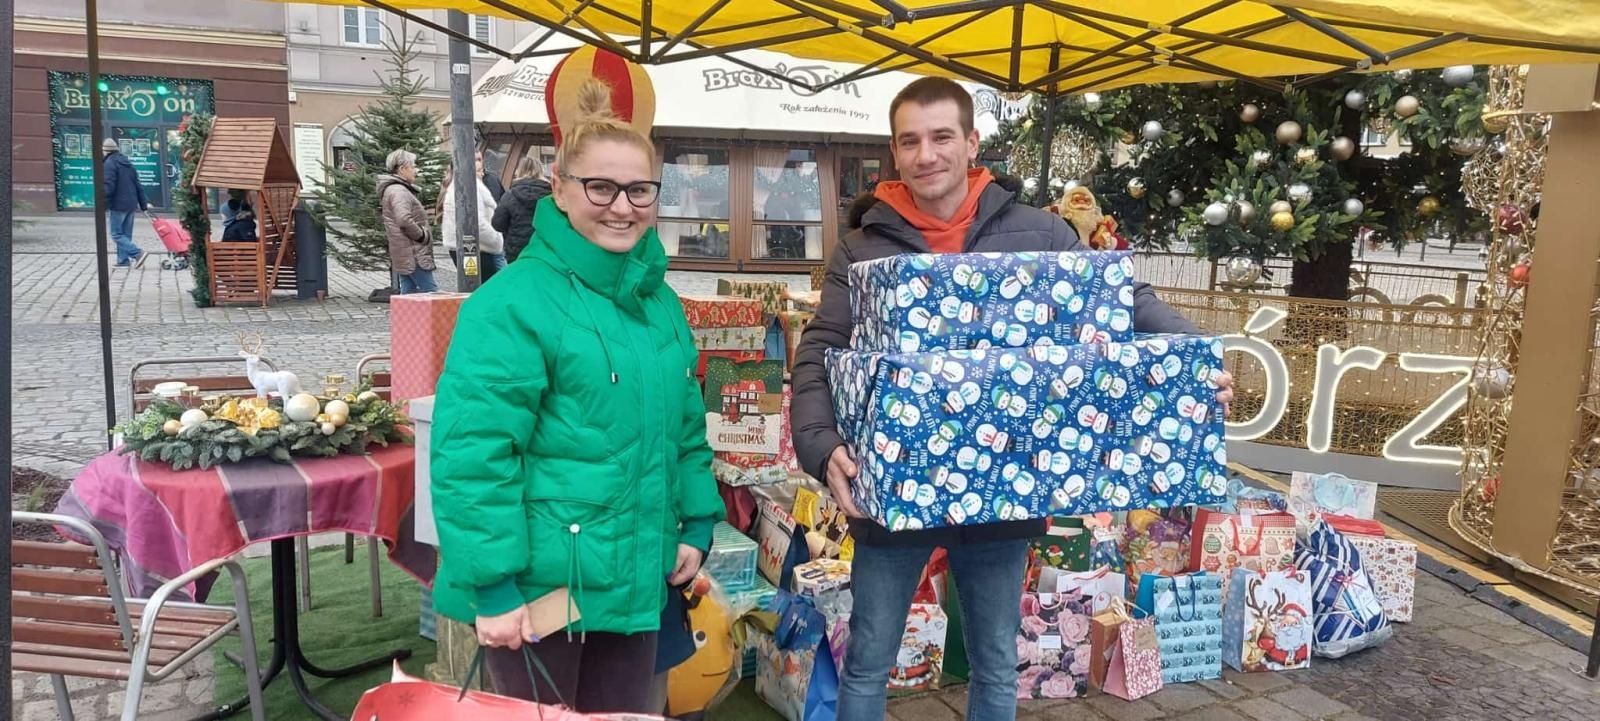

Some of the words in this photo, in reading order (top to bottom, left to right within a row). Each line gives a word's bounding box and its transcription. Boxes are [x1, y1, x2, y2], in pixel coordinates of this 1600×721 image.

[504, 88, 544, 100] SZYMOCIC
[780, 104, 801, 114] Rok
[850, 110, 870, 120] 1997
[718, 432, 766, 444] CHRISTMAS
